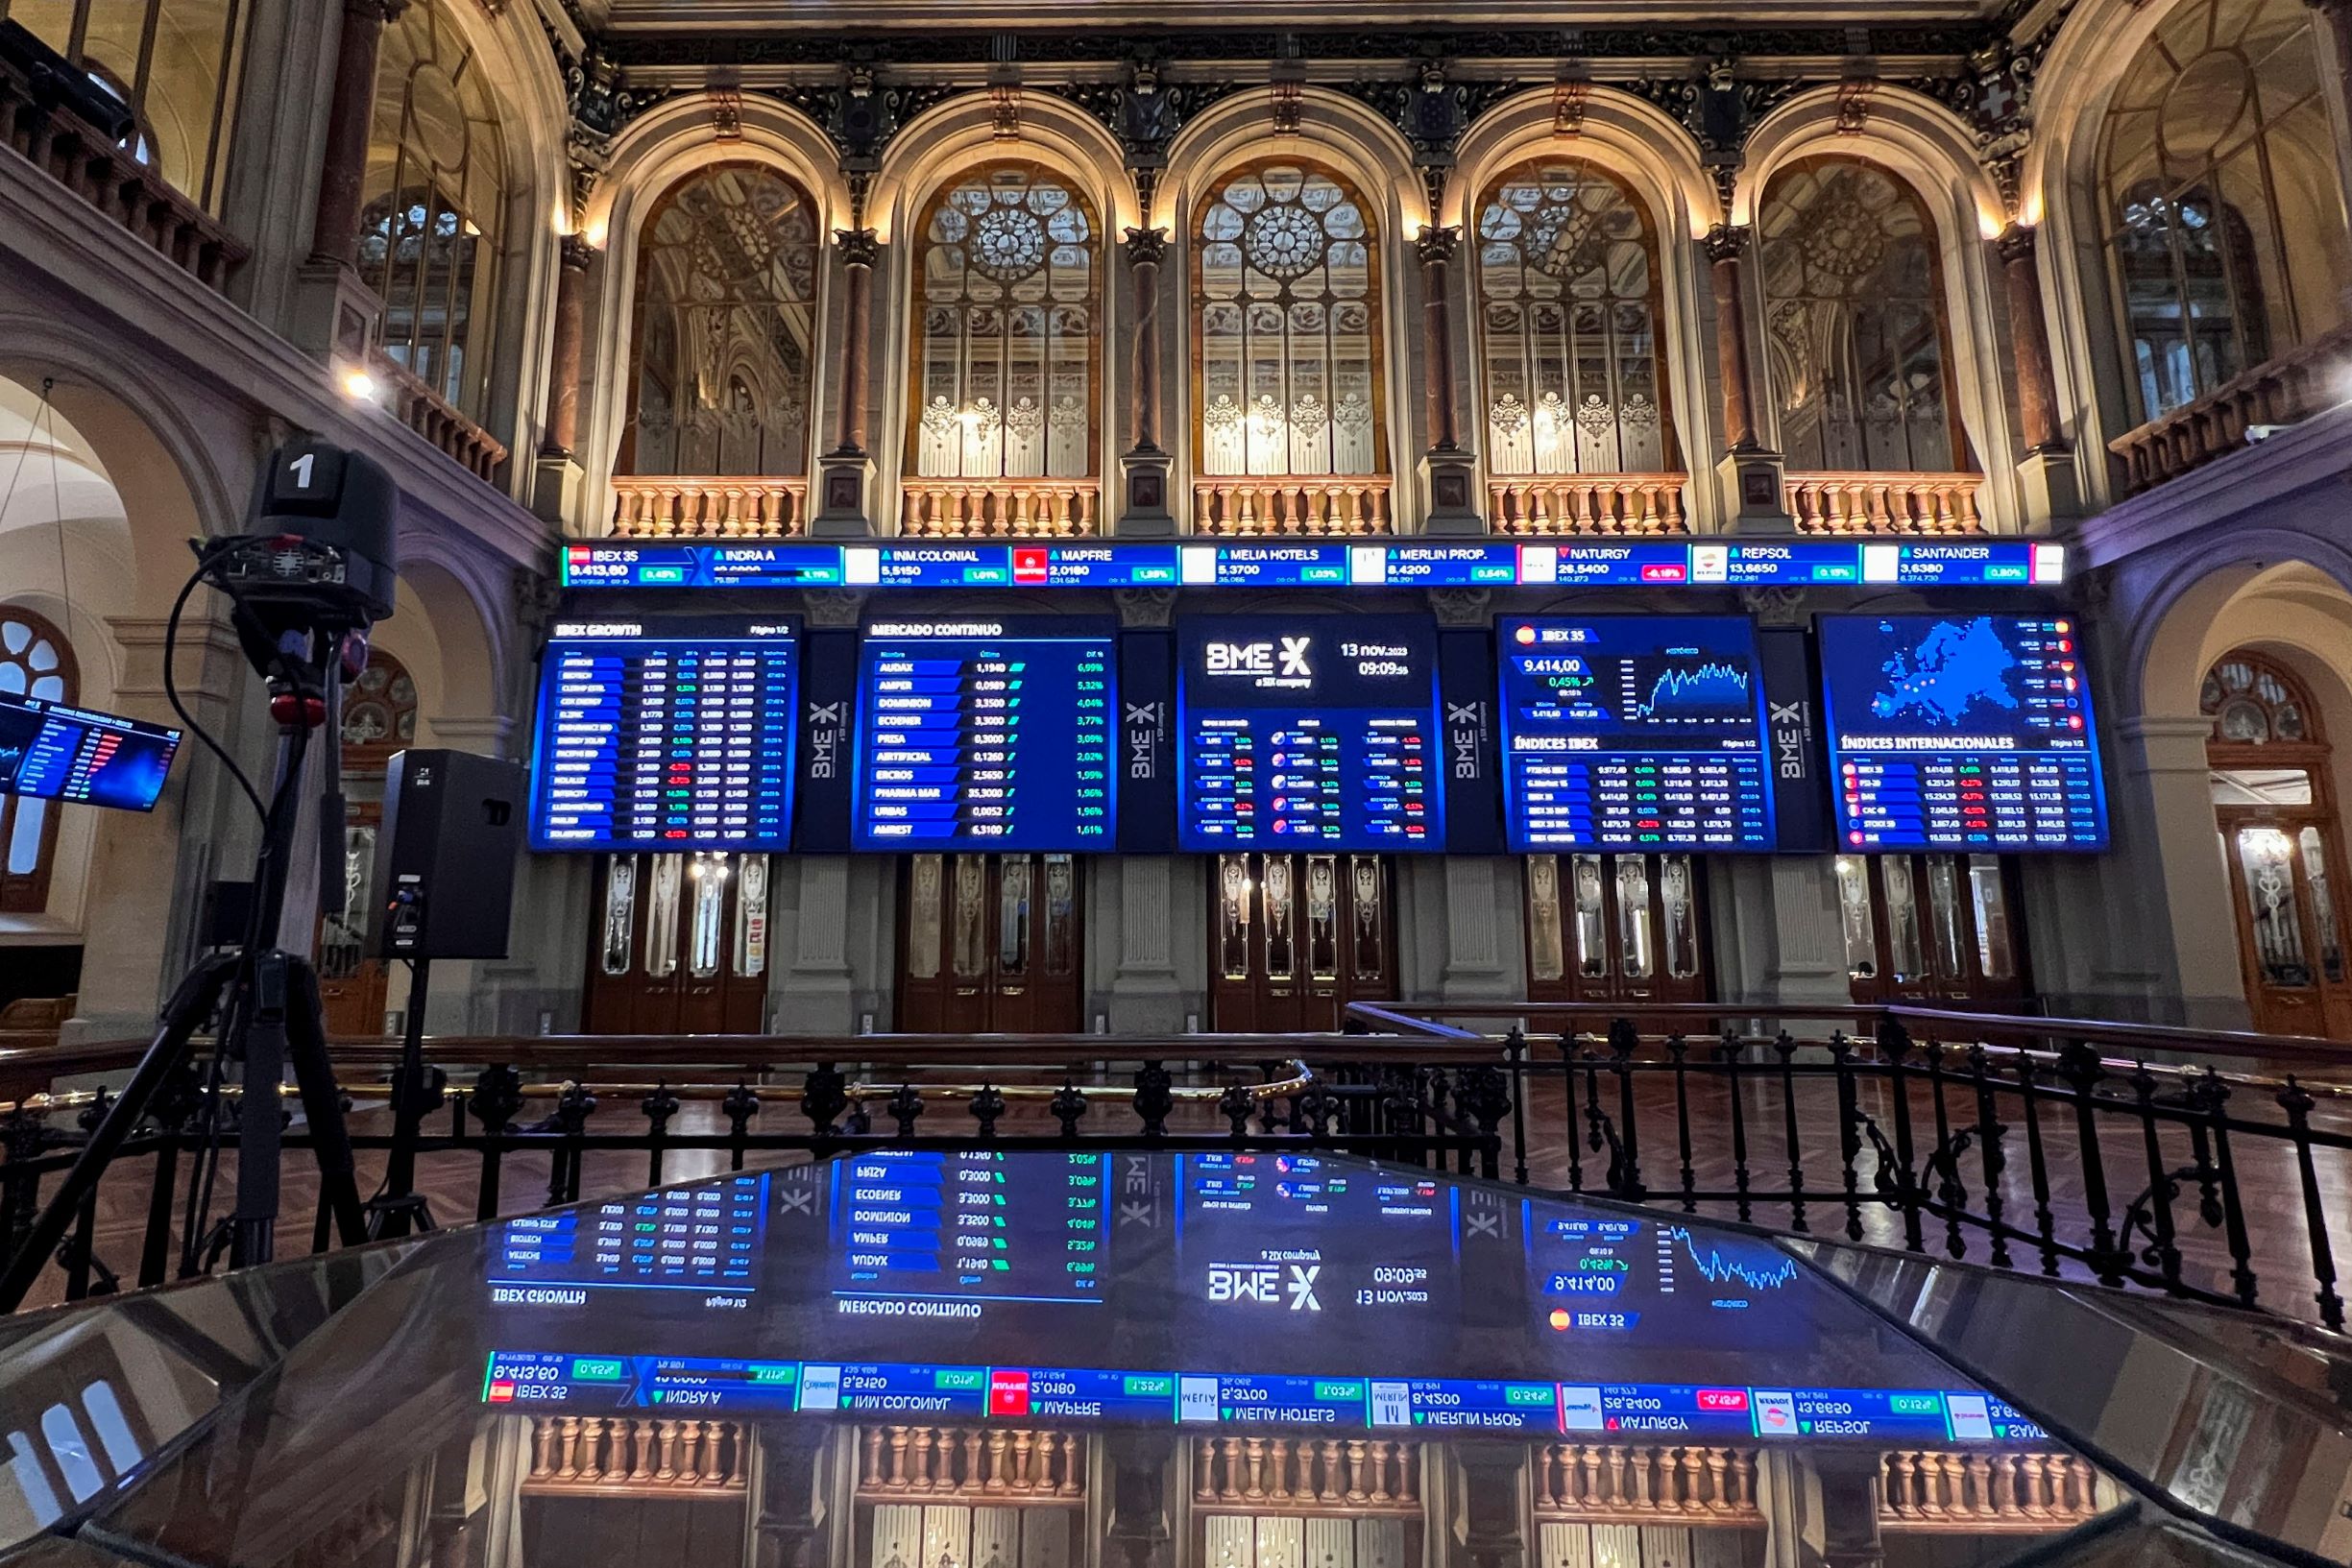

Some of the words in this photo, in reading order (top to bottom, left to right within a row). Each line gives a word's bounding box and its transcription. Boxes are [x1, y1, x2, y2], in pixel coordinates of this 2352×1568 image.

[289, 453, 314, 489] 1
[593, 550, 621, 562] IBEX
[725, 550, 764, 562] INDRA
[765, 550, 776, 562] A
[893, 550, 980, 562] INM.COLONIAL
[1061, 550, 1113, 562] MAPFRE
[1230, 549, 1268, 561] MELIA
[1270, 549, 1320, 561] HOTELS
[1399, 549, 1446, 561] MERLIN
[1448, 549, 1488, 560] PROP.
[1570, 548, 1631, 560] NATURGY
[1741, 547, 1792, 559] REPSOL
[1912, 547, 1990, 559] SANTANDER
[1218, 565, 1260, 575] 5,3700
[1387, 565, 1432, 575] 8,4200
[1558, 564, 1610, 574] 26,5400
[587, 624, 643, 636] GROWTH
[871, 624, 934, 636] MERCADO
[934, 624, 1003, 636] CONTINUO
[1541, 630, 1569, 641] IBEX
[1570, 630, 1586, 641] 35
[1206, 642, 1274, 669] BME
[1341, 643, 1358, 657] 13
[880, 663, 914, 672] AUDAX
[1523, 659, 1581, 673] 9.414,00
[1548, 676, 1581, 688] 0,45%
[879, 698, 932, 708] DOMINION
[877, 734, 907, 743] PRISA
[1514, 736, 1567, 750] ÍNDICES
[1567, 737, 1599, 750] IBEX
[1840, 736, 1894, 749] ÍNDICES
[1895, 736, 2015, 749] INTERNACIONALES
[812, 730, 833, 778] BME
[1130, 730, 1152, 779] BME
[1454, 730, 1475, 779] BME
[1777, 730, 1802, 779] BME
